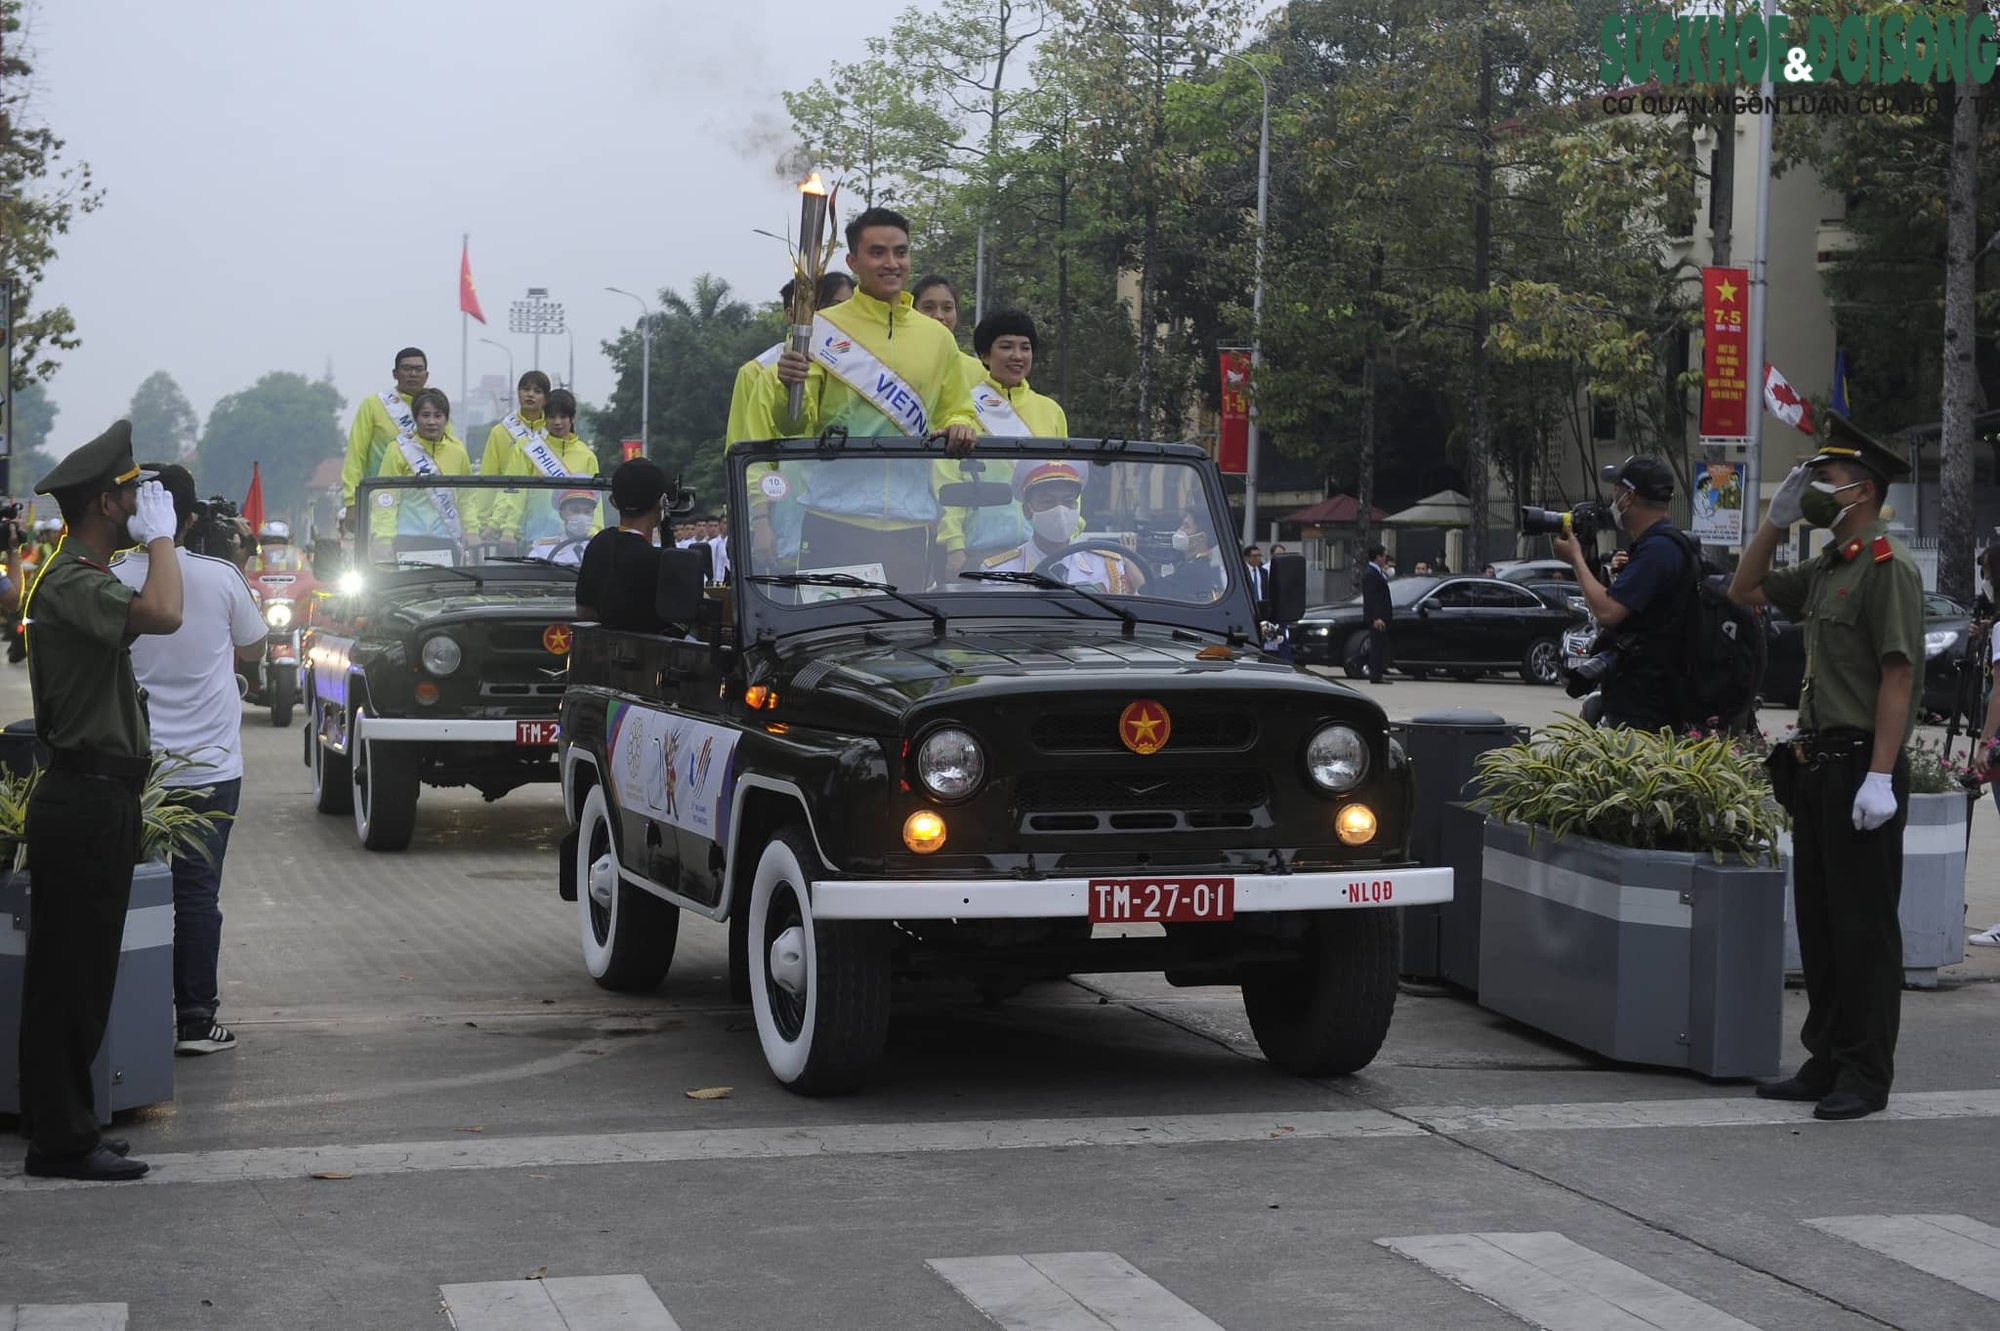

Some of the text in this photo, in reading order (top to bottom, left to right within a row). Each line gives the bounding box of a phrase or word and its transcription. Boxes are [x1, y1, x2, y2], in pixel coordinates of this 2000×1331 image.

[876, 373, 930, 437] VIETN
[520, 724, 560, 743] TM-2
[1095, 884, 1224, 918] TM-27-01
